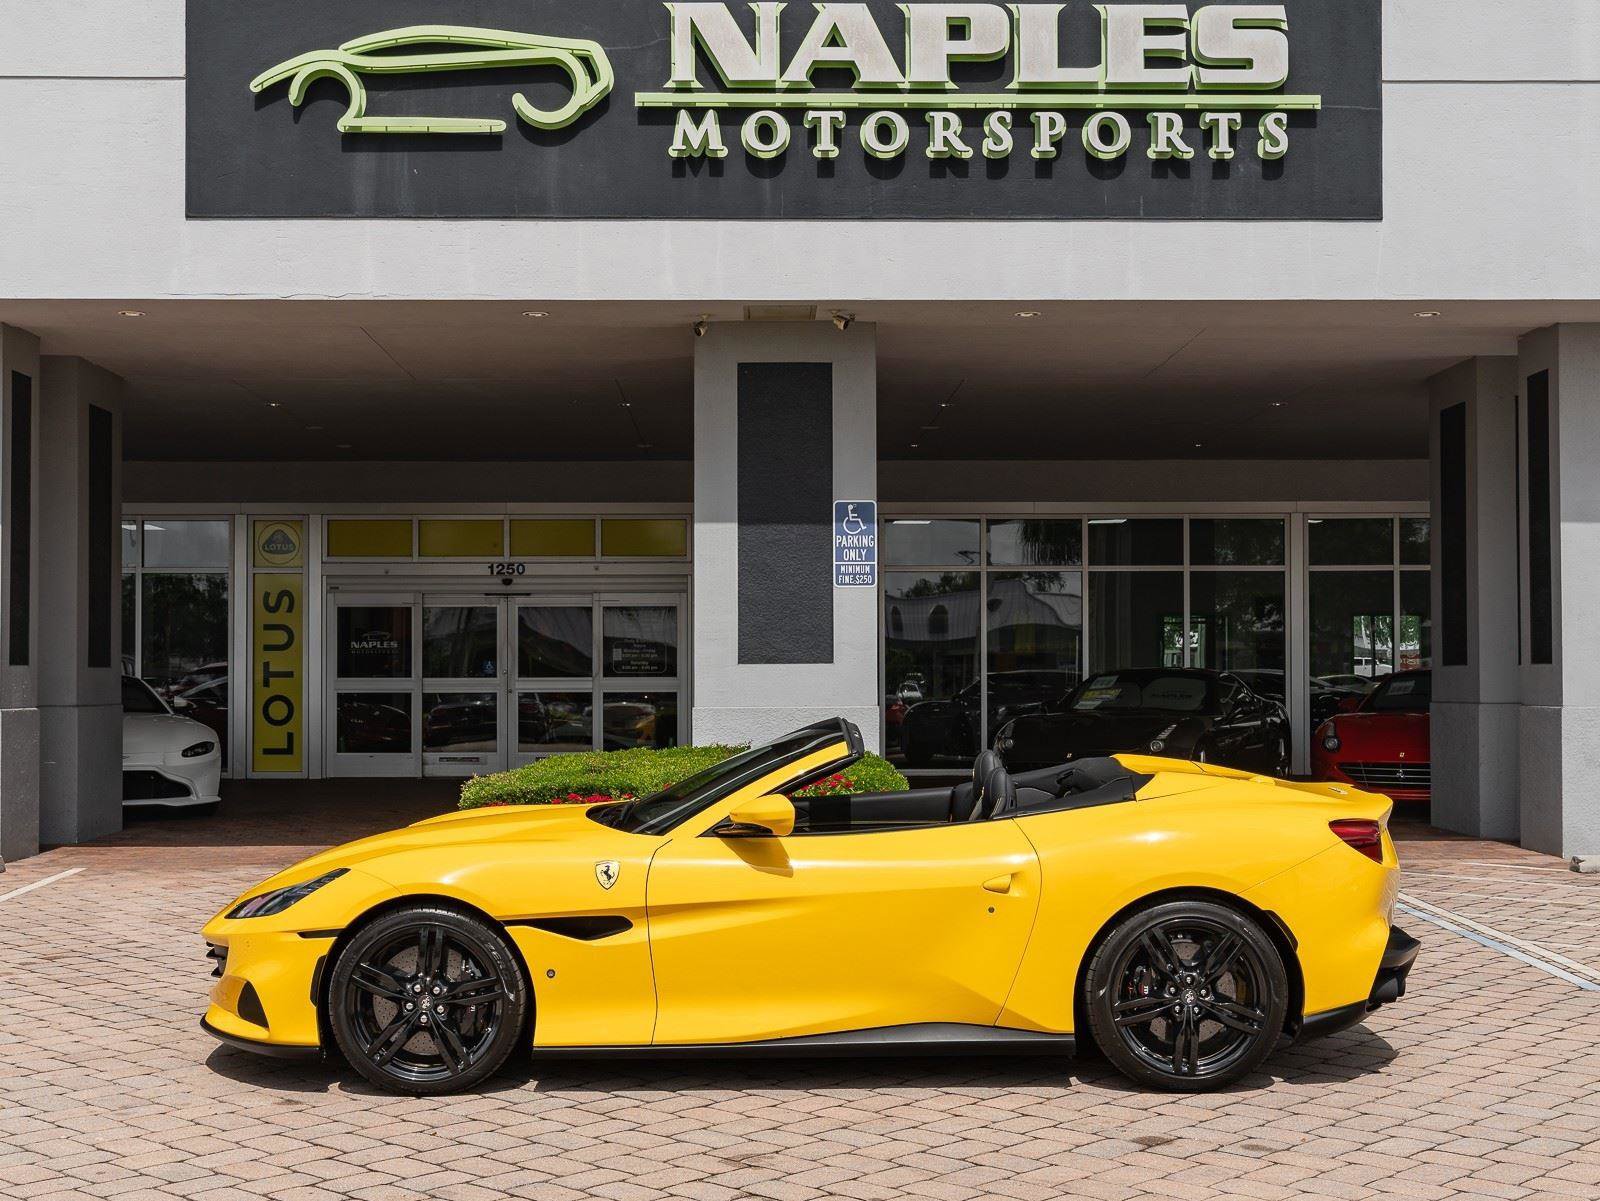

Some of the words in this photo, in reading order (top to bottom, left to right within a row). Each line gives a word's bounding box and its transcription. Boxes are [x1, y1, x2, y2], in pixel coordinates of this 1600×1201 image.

[663, 3, 1289, 89] NAPLES
[667, 110, 1289, 158] MOTORSPORTS
[836, 535, 874, 547] PARKING
[843, 549, 867, 561] ONLY
[488, 562, 526, 575] 1250
[840, 565, 870, 574] MINIMUM
[262, 589, 295, 755] LOTUS
